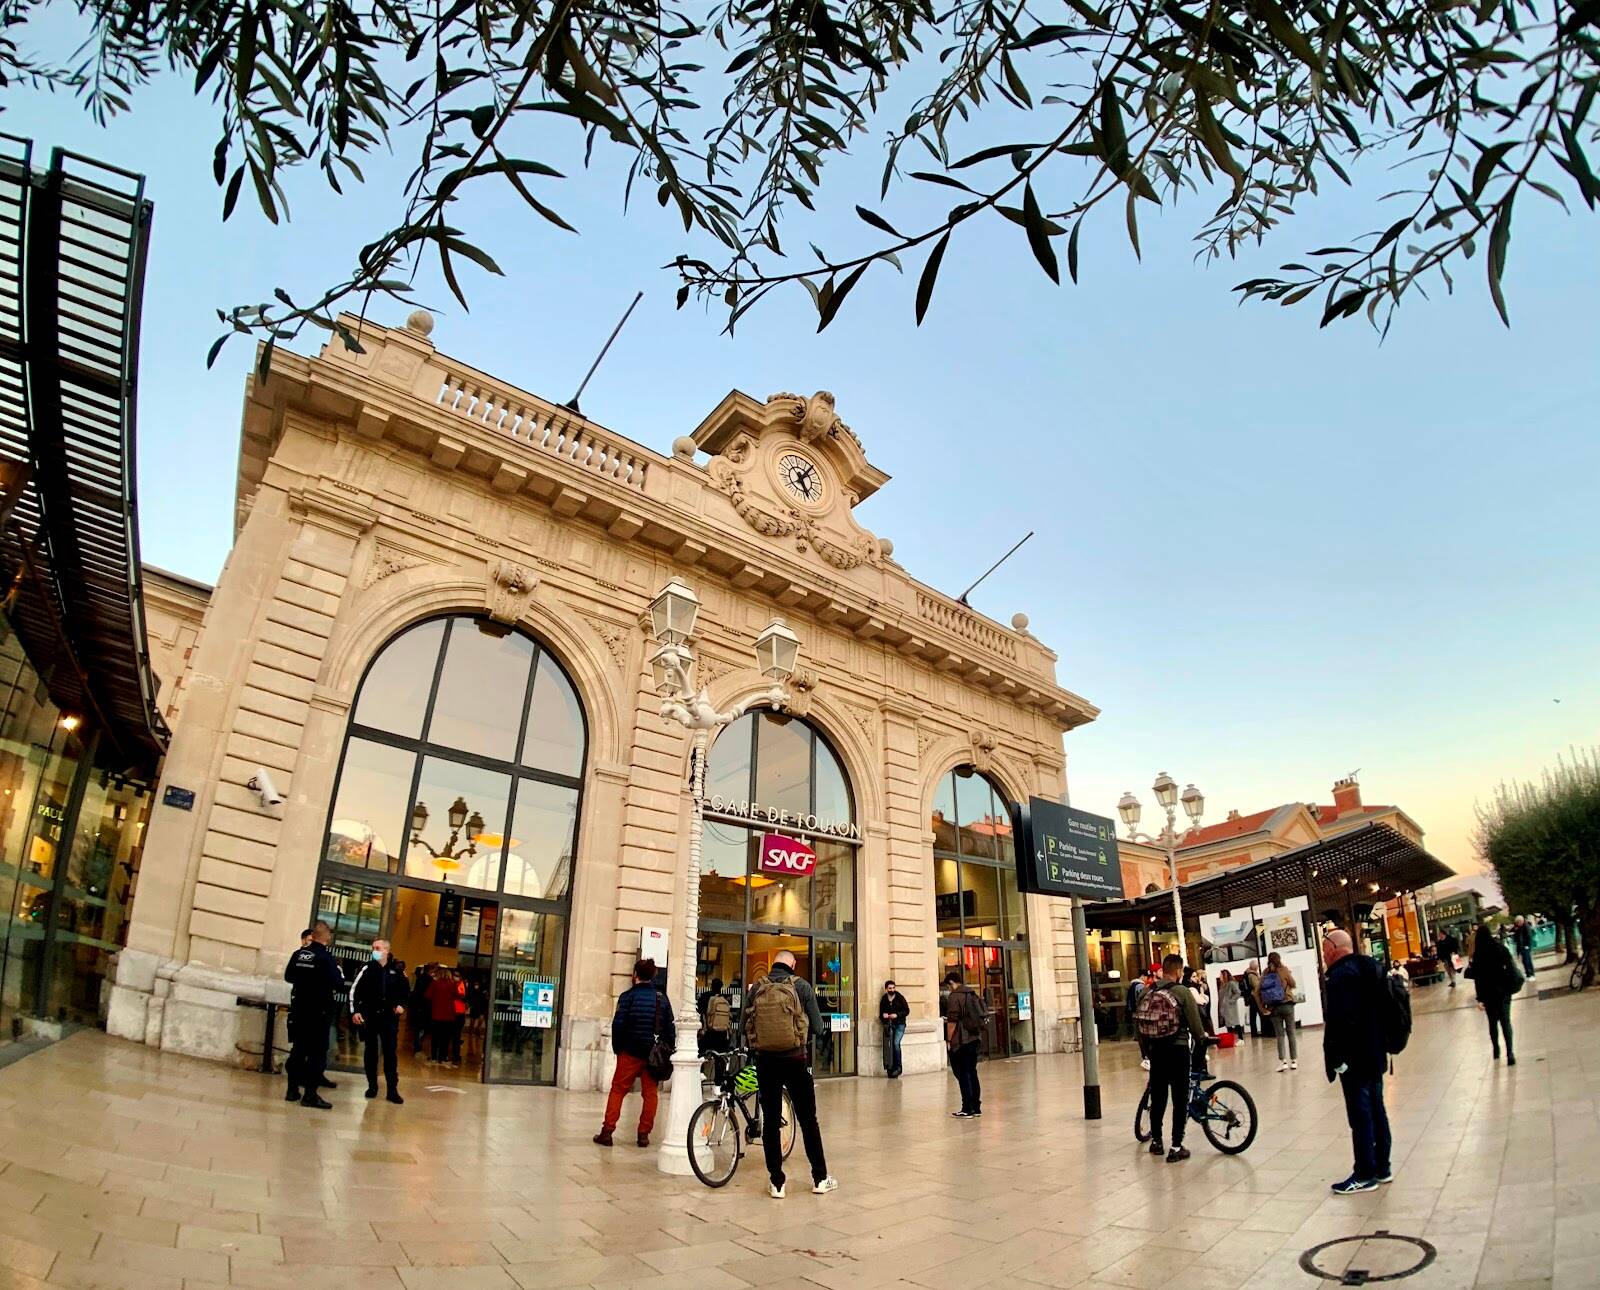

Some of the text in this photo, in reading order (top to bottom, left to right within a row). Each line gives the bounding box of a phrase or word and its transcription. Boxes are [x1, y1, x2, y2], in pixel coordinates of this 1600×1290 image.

[37, 804, 64, 821] PAUL
[710, 794, 862, 839] GARE DE TOULON
[1049, 839, 1056, 852] P
[1059, 841, 1077, 854] Parking
[764, 848, 816, 871] SNCF
[1052, 866, 1058, 879] P
[1062, 868, 1081, 880] Parking
